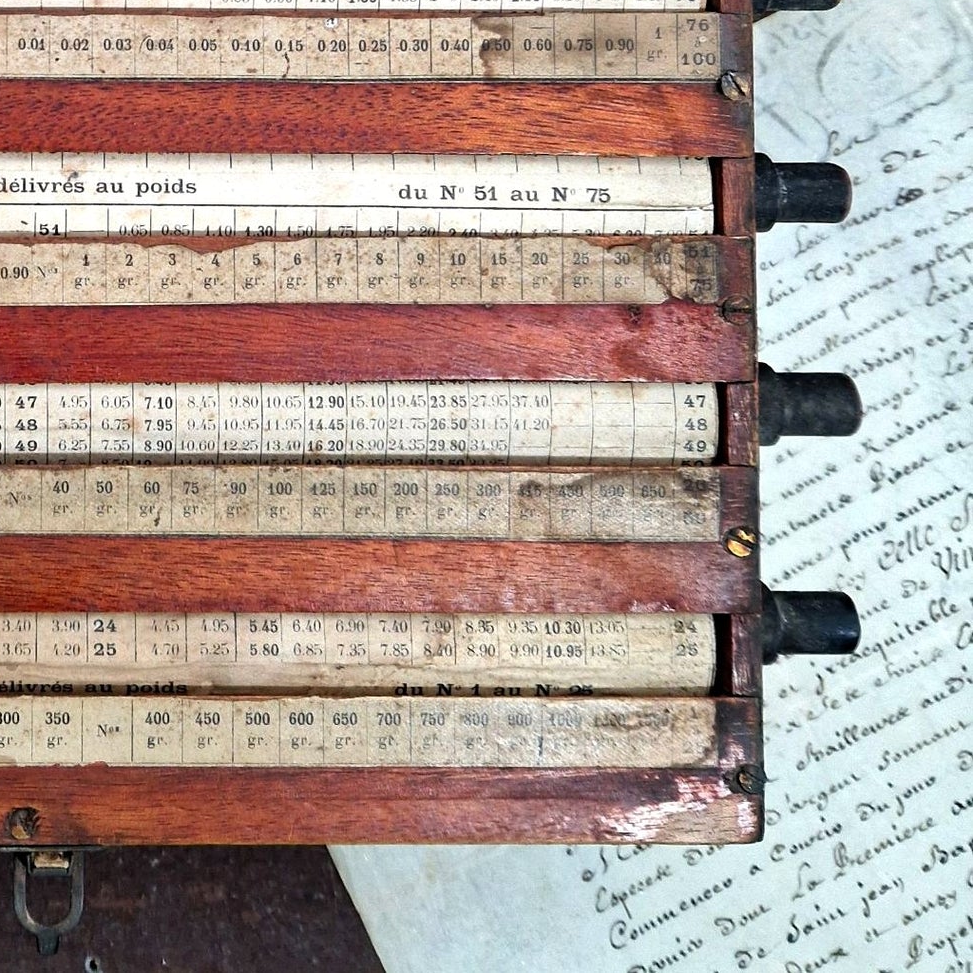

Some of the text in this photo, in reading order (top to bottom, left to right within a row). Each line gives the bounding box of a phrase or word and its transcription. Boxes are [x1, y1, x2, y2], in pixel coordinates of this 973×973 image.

[96, 180, 123, 193] au
[136, 178, 197, 195] poids
[399, 186, 427, 200] du
[475, 187, 497, 200] 51
[511, 187, 539, 201] au
[586, 188, 611, 203] 75
[308, 395, 345, 409] 12.90
[94, 644, 117, 656] 25
[85, 682, 112, 693] au
[127, 681, 187, 694] poids
[145, 712, 170, 725] 400
